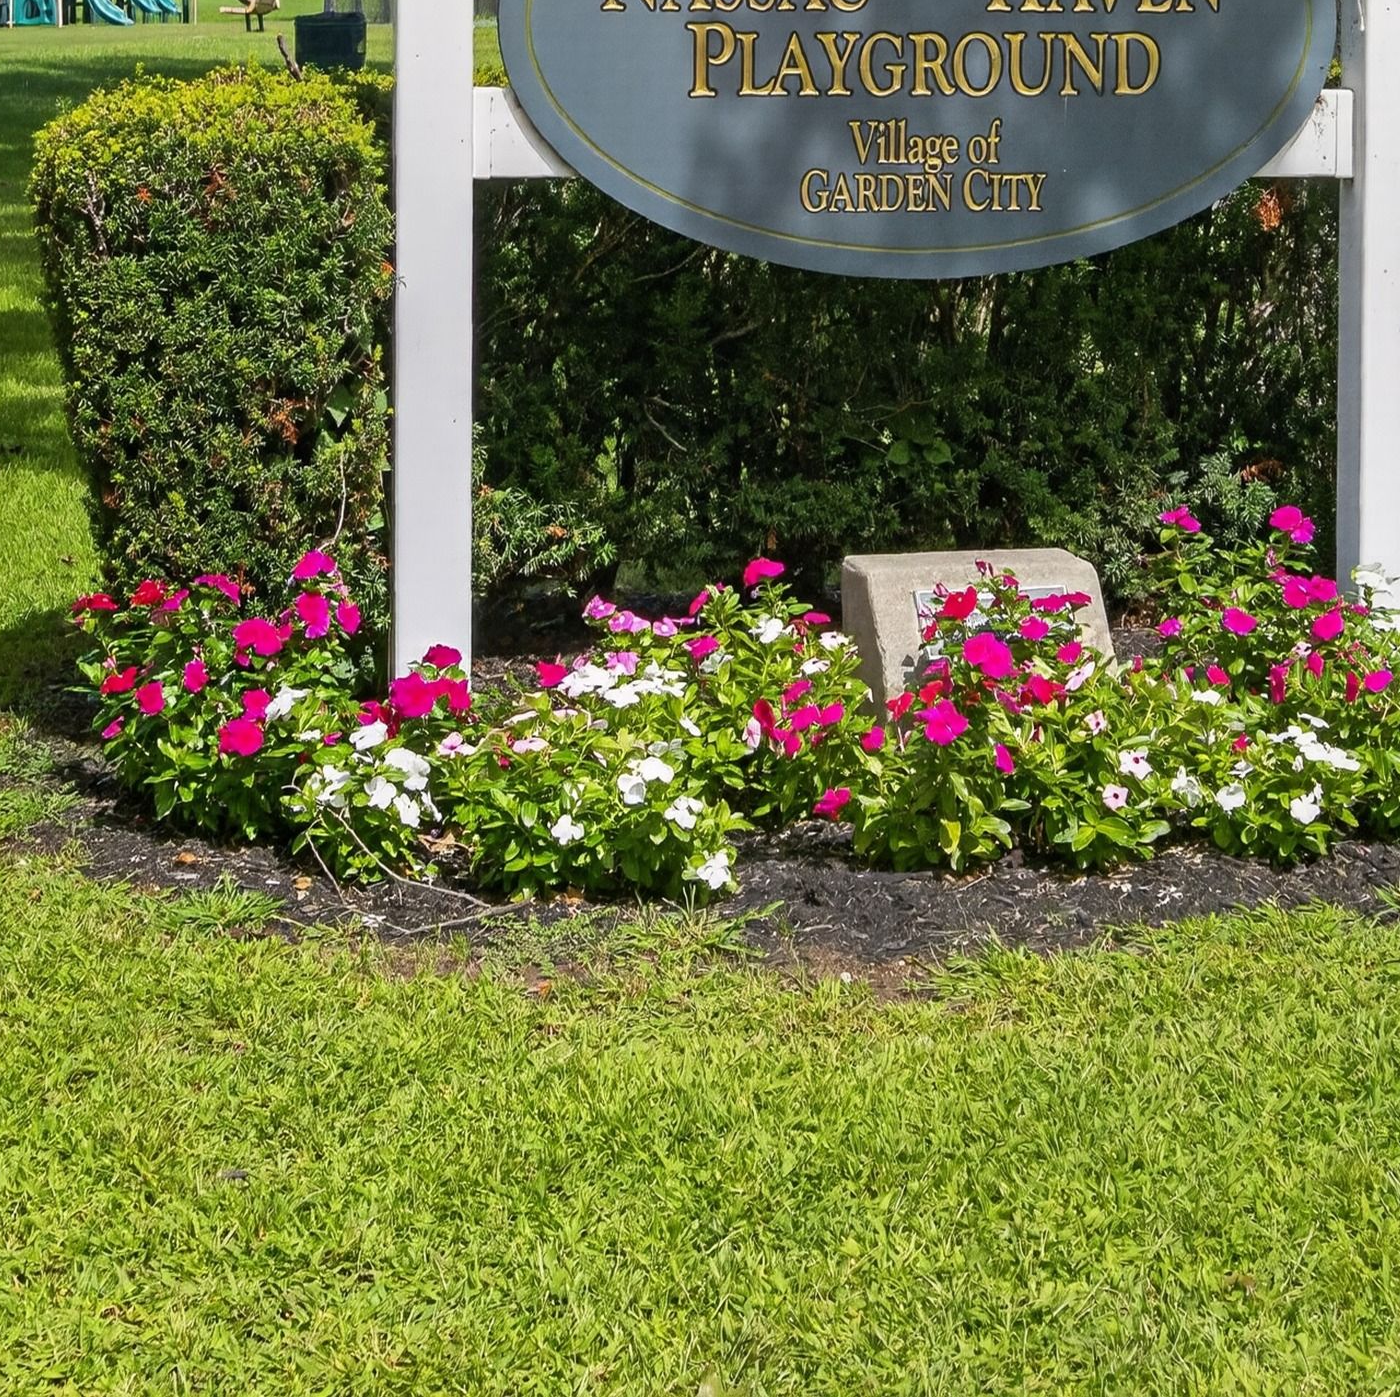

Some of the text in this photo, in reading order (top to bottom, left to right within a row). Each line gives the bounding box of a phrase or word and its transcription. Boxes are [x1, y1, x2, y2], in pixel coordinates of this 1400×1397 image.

[685, 21, 1162, 99] PLAYGROUND
[848, 117, 1003, 174] Village of
[799, 168, 1047, 213] GARDEN CITY
